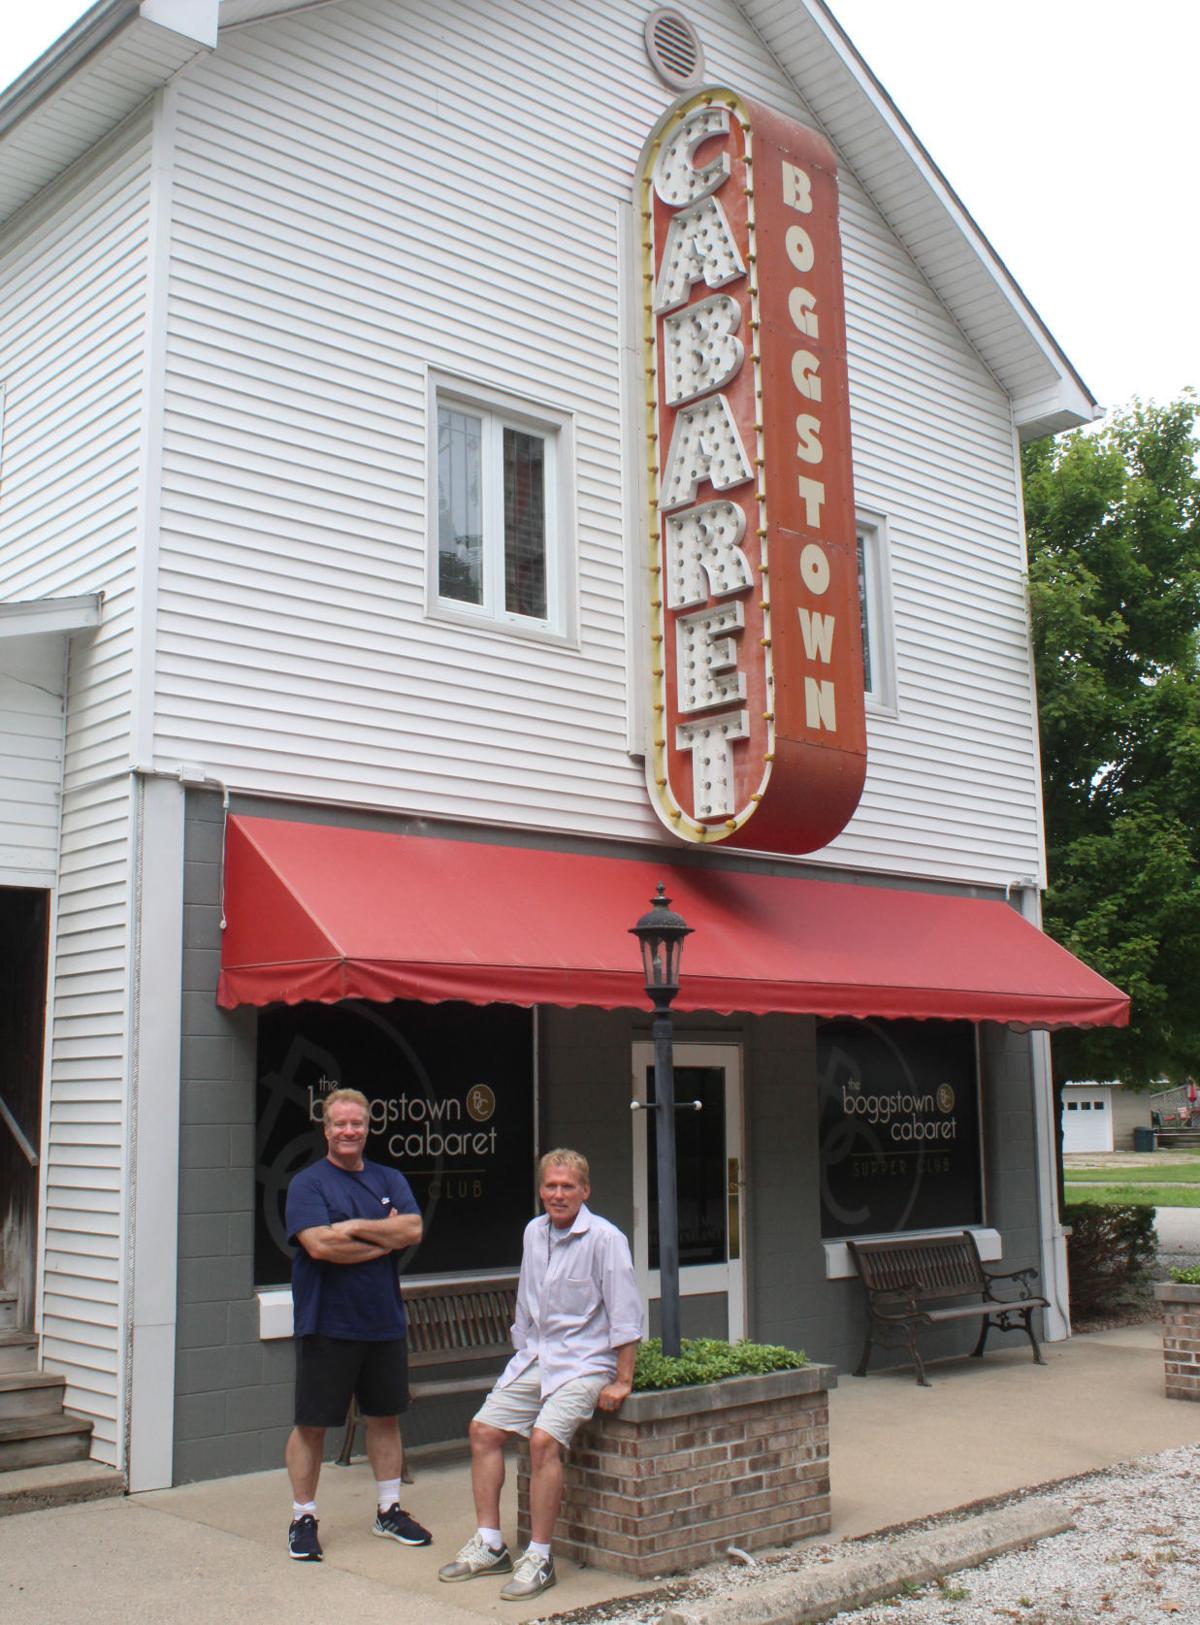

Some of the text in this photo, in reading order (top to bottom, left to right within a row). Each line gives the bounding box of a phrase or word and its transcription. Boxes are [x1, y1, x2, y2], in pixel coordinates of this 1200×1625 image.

[652, 107, 754, 819] CABARET
[782, 160, 836, 732] BOGGSTOWN
[318, 1075, 338, 1091] the
[308, 1086, 461, 1135] bgstown
[842, 1085, 934, 1124] boggstown
[388, 1121, 497, 1158] cabaret
[891, 1113, 957, 1141] cabaret
[428, 1180, 483, 1200] CLUB
